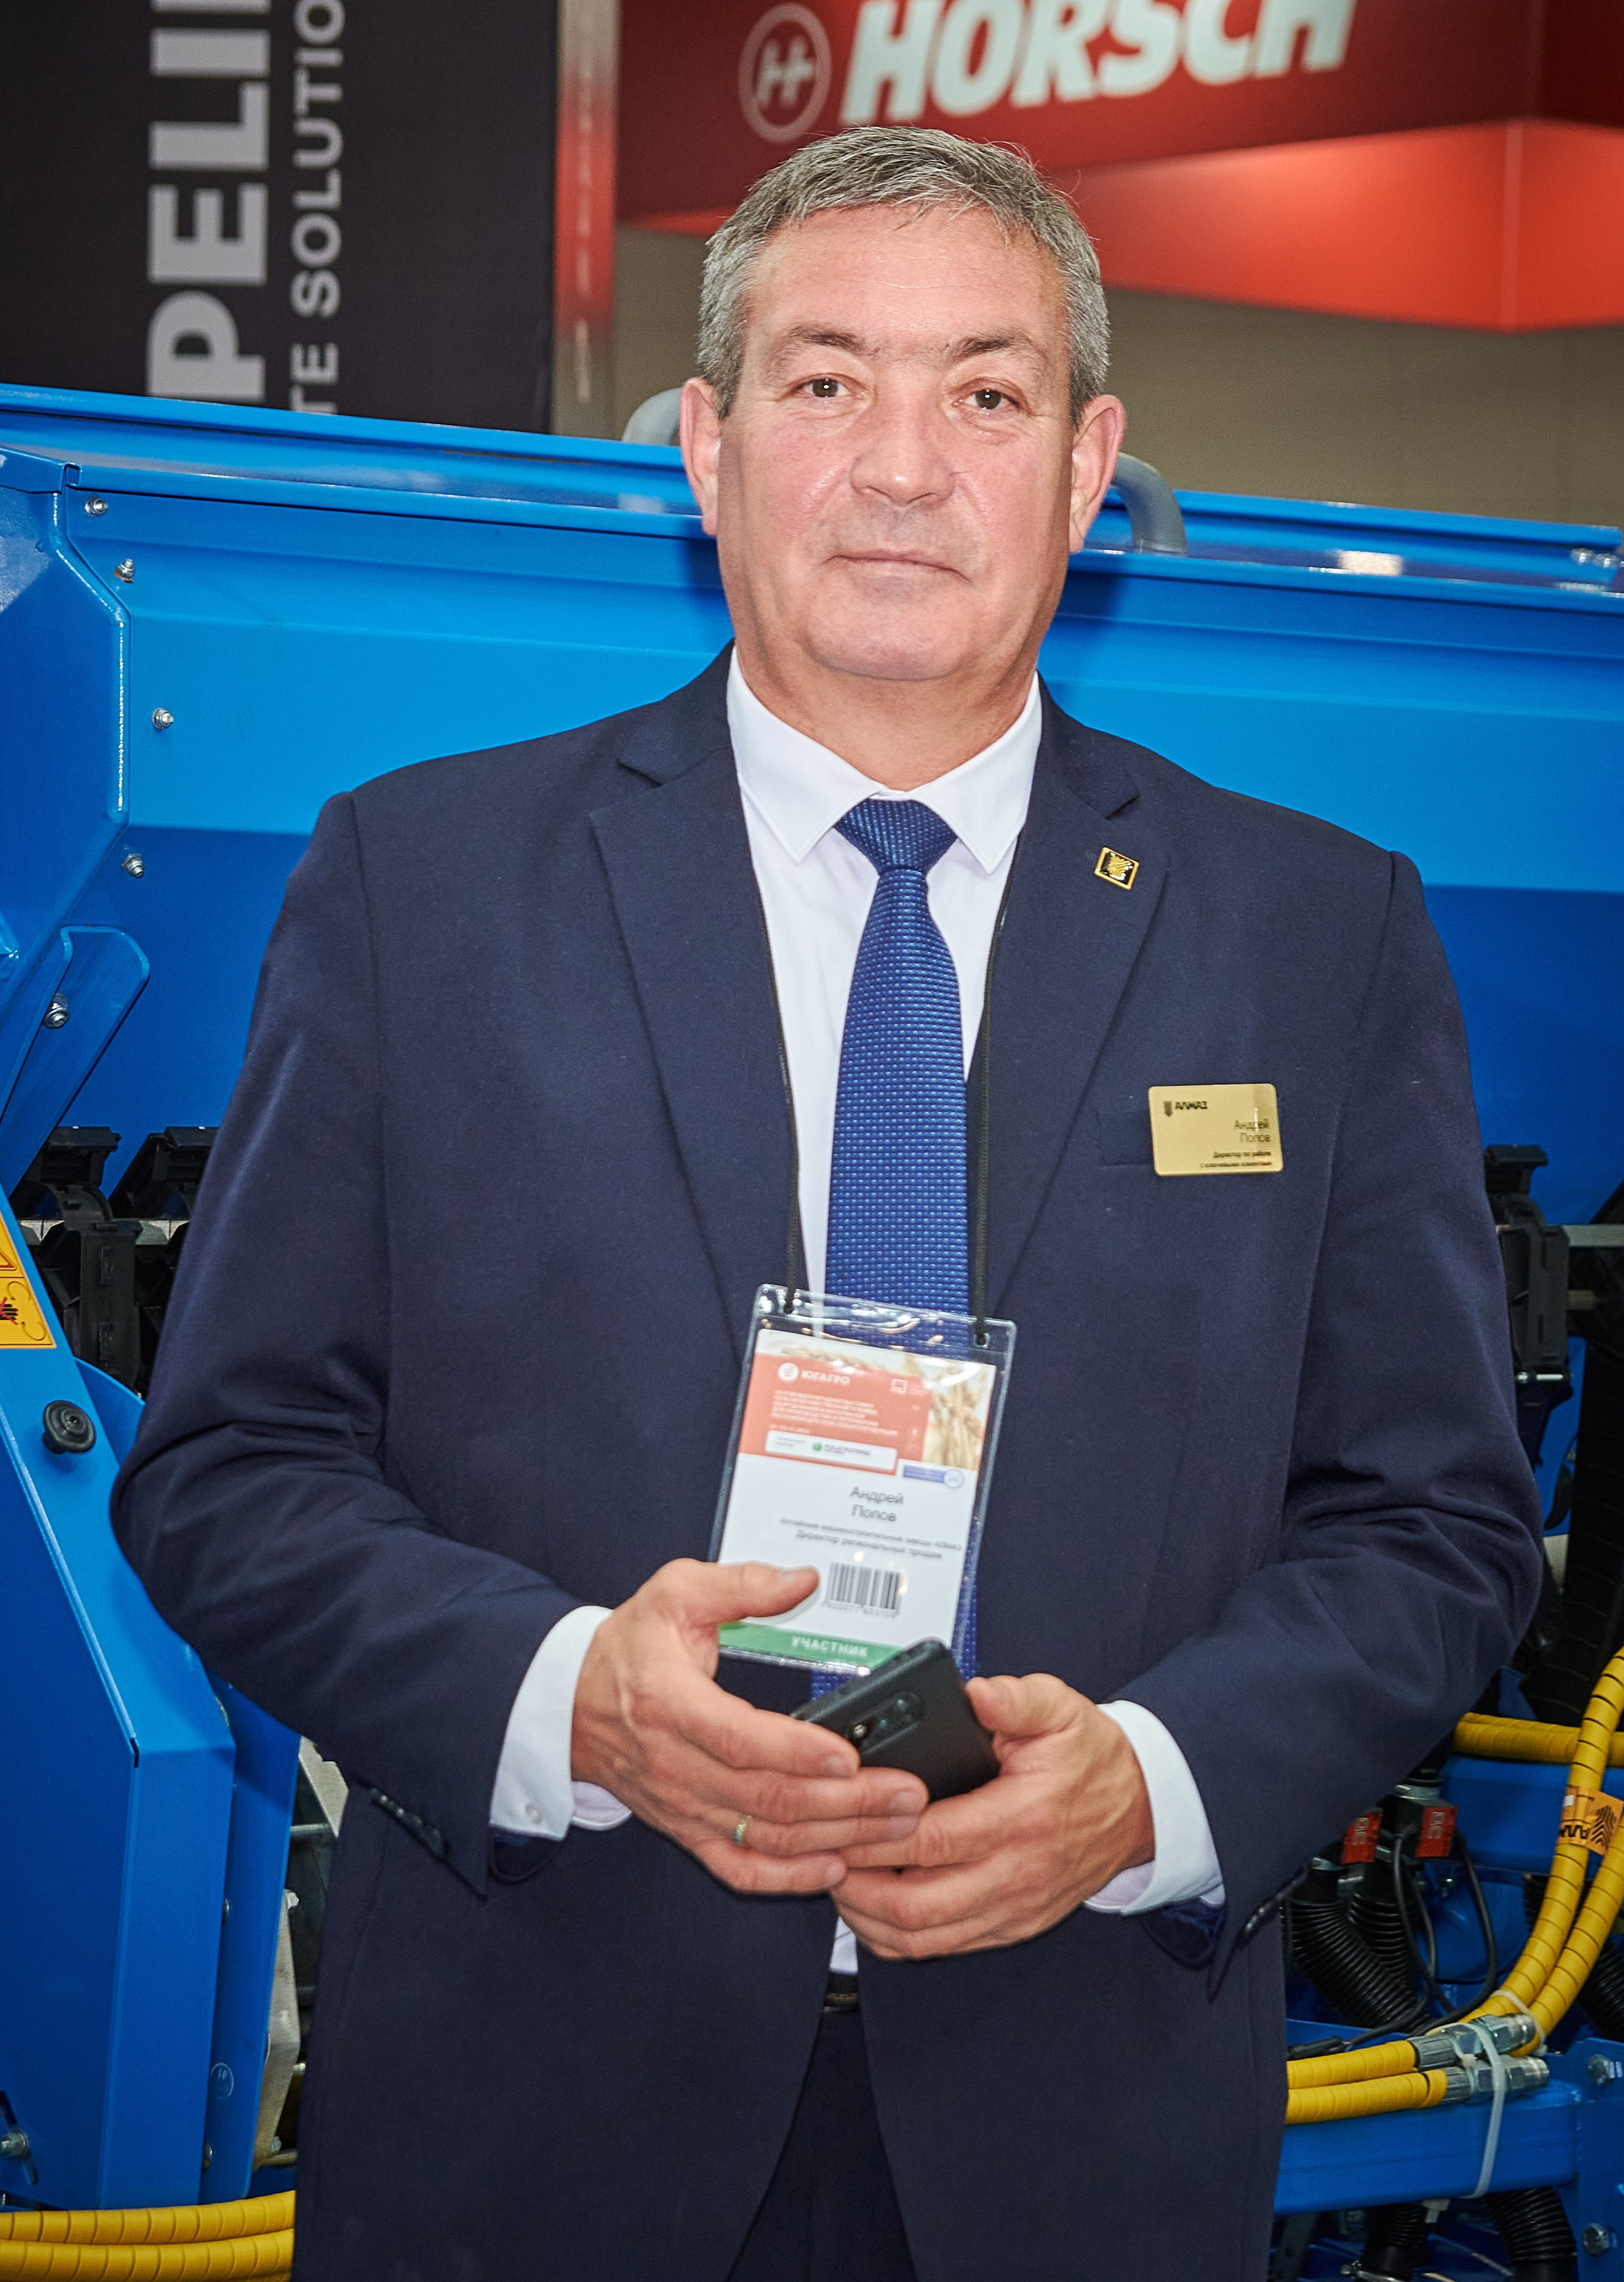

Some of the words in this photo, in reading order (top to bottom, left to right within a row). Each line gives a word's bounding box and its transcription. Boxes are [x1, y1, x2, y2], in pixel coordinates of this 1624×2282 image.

[839, 0, 1357, 124] HORSCH
[147, 0, 272, 405] PELI
[1234, 1118, 1269, 1132] Андрей
[1240, 1132, 1270, 1143] Попов
[849, 1486, 903, 1505] Андрей
[851, 1504, 897, 1522] Попов
[791, 1636, 868, 1657] УЧАСТНИК
